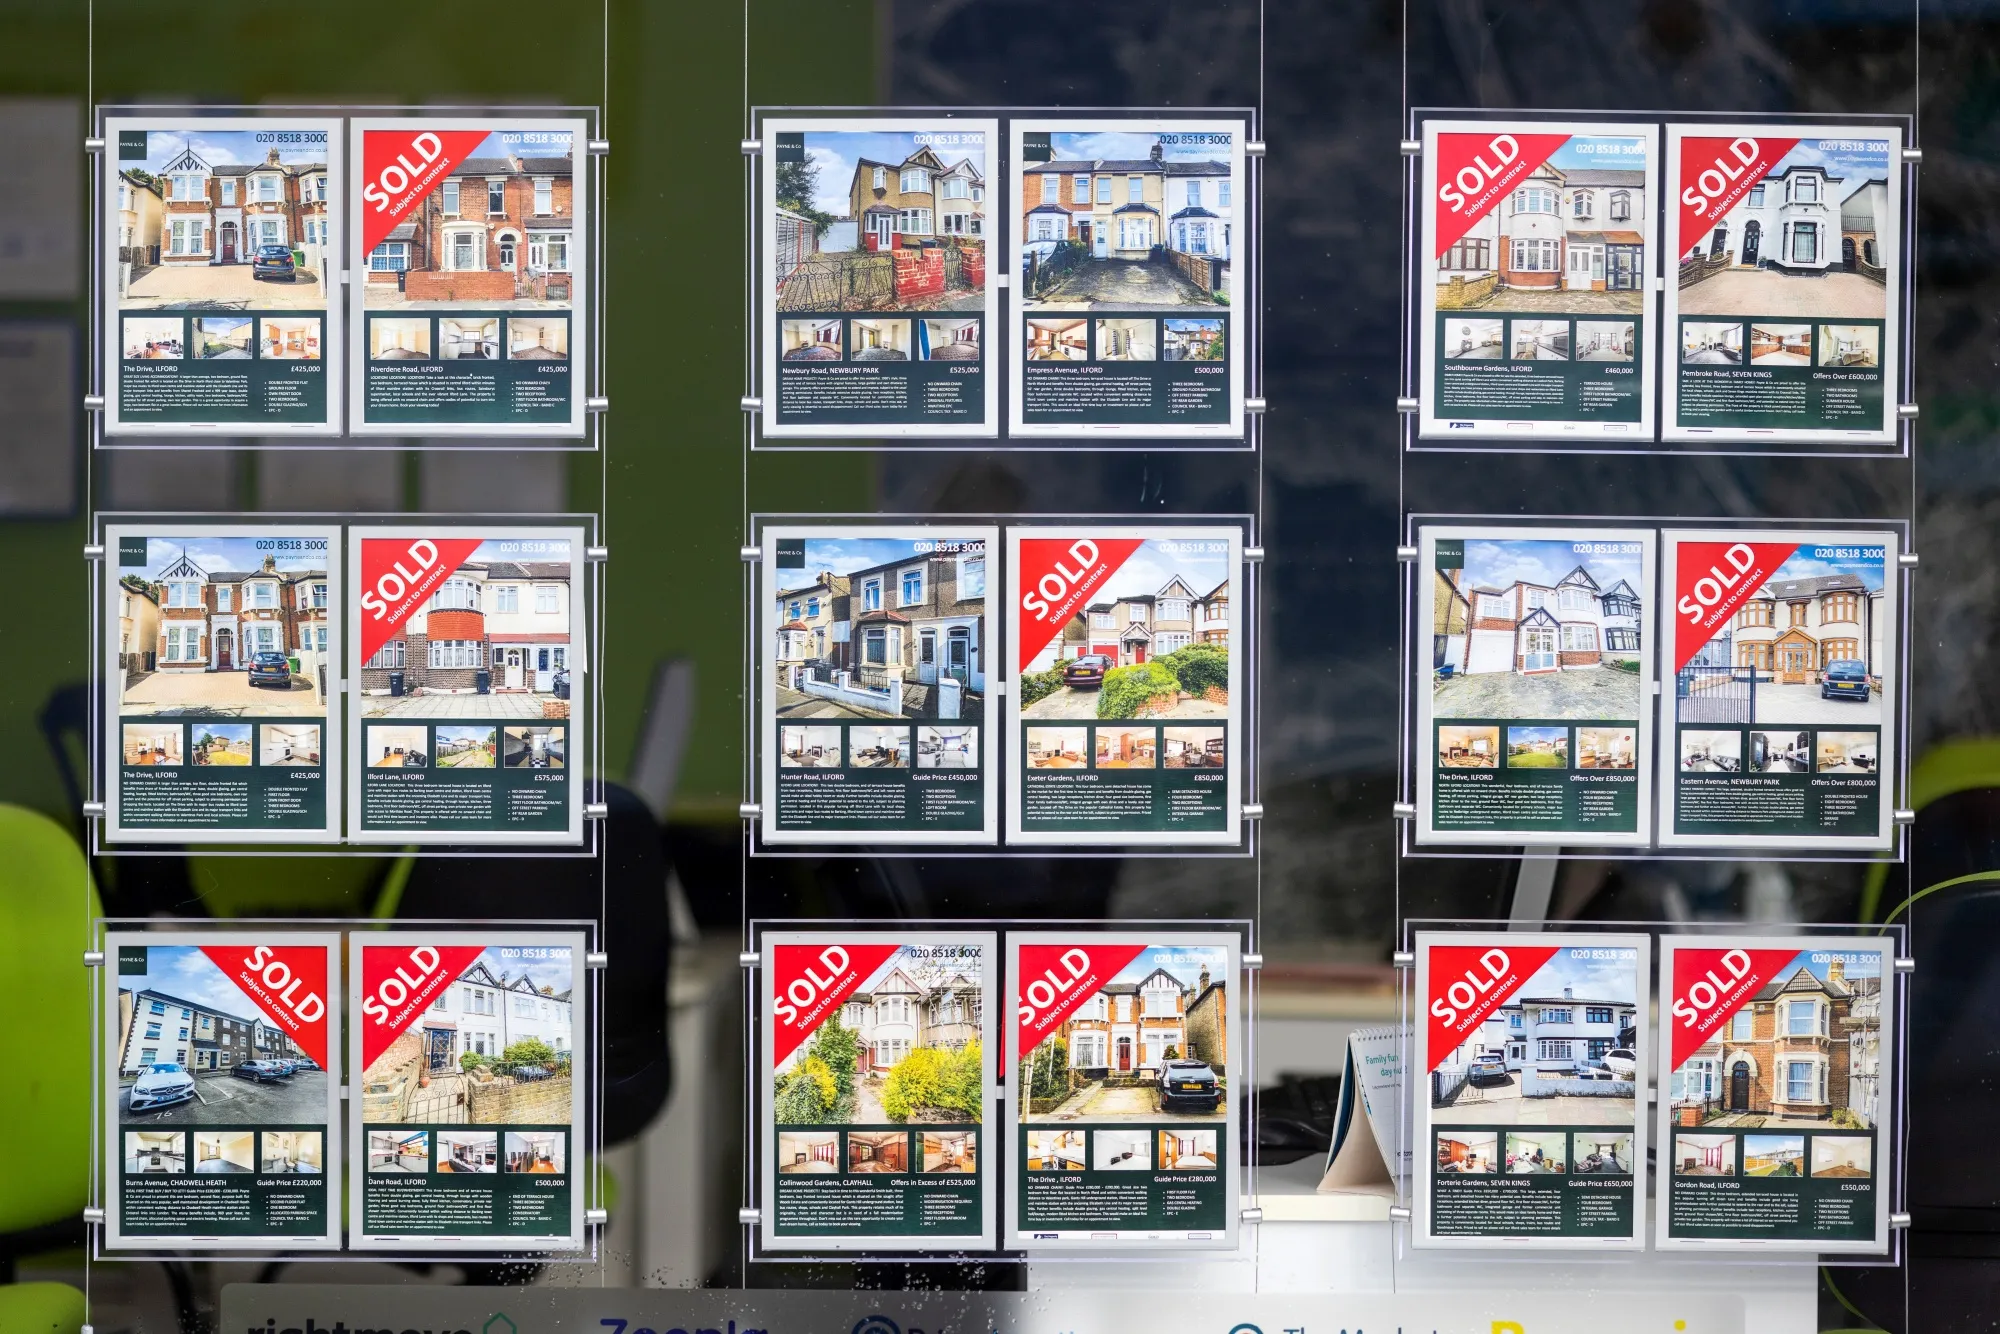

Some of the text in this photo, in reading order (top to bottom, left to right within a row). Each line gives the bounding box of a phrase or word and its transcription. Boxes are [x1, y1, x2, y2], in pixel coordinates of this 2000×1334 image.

[256, 134, 274, 142] 020
[277, 134, 301, 142] 8518
[364, 132, 442, 212] SOLD
[1440, 135, 1518, 213] SOLD
[1682, 139, 1759, 216] SOLD
[390, 192, 416, 216] Subject
[423, 158, 450, 185] contract
[1465, 193, 1490, 217] Subject
[1498, 161, 1526, 186] contract
[1708, 195, 1734, 220] Subject
[1741, 162, 1767, 188] contract
[136, 365, 154, 373] Drive,
[290, 365, 320, 373] £425,000
[402, 366, 419, 374] Road,
[538, 366, 567, 374] £425,000
[782, 367, 809, 376] Newbury
[811, 367, 828, 375] Road,
[949, 366, 979, 374] £525,000
[1027, 366, 1053, 375] Empress
[1054, 367, 1079, 375] Avenue,
[1194, 367, 1223, 375] £500,000
[1483, 365, 1509, 373] Gardens,
[1605, 367, 1633, 375] £460,000
[1713, 370, 1730, 378] Road,
[1848, 373, 1877, 381] £600,000
[362, 540, 438, 620] SOLD
[1023, 540, 1099, 620] SOLD
[1678, 544, 1754, 624] SOLD
[388, 599, 413, 624] Subject
[420, 564, 446, 592] contract
[1050, 598, 1075, 624] Subject
[1081, 564, 1107, 591] contract
[1704, 569, 1762, 628] Subject to contract
[135, 771, 153, 779] Drive,
[290, 772, 320, 780] £425,000
[384, 774, 400, 782] Lane,
[534, 774, 563, 782] £575,000
[803, 773, 820, 781] Road,
[948, 774, 977, 782] £450,000
[1047, 774, 1074, 782] Gardens,
[1194, 774, 1223, 782] £850,000
[1451, 774, 1469, 782] Drive,
[1605, 775, 1635, 783] £850,000
[1704, 778, 1729, 786] Avenue,
[1846, 779, 1876, 787] £800,000
[244, 946, 324, 1024] SOLD
[364, 947, 440, 1024] SOLD
[775, 946, 849, 1025] SOLD
[1020, 949, 1090, 1026] SOLD
[1431, 949, 1509, 1027] SOLD
[1672, 950, 1750, 1027] SOLD
[240, 972, 299, 1030] Subject to contract
[390, 1004, 414, 1028] Subject
[422, 970, 448, 996] contract
[798, 1005, 823, 1029] Subject
[830, 972, 857, 998] contract
[1036, 1007, 1062, 1030] Subject
[1070, 975, 1097, 1000] contract
[1698, 1008, 1724, 1031] Subject
[1732, 975, 1758, 1001] contract
[1457, 1008, 1483, 1032] Subject
[1490, 975, 1517, 1001] contract
[1365, 1055, 1387, 1065] Family
[1380, 1068, 1392, 1077] day
[292, 1179, 321, 1187] £220,000
[385, 1178, 402, 1186] Road,
[535, 1179, 564, 1187] £500,000
[946, 1179, 975, 1187] £525,000
[1188, 1175, 1216, 1183] £280,000
[1461, 1179, 1489, 1187] Gardens,
[1603, 1180, 1632, 1188] £650,000
[1699, 1182, 1716, 1190] Road,
[1840, 1184, 1870, 1192] £550,000
